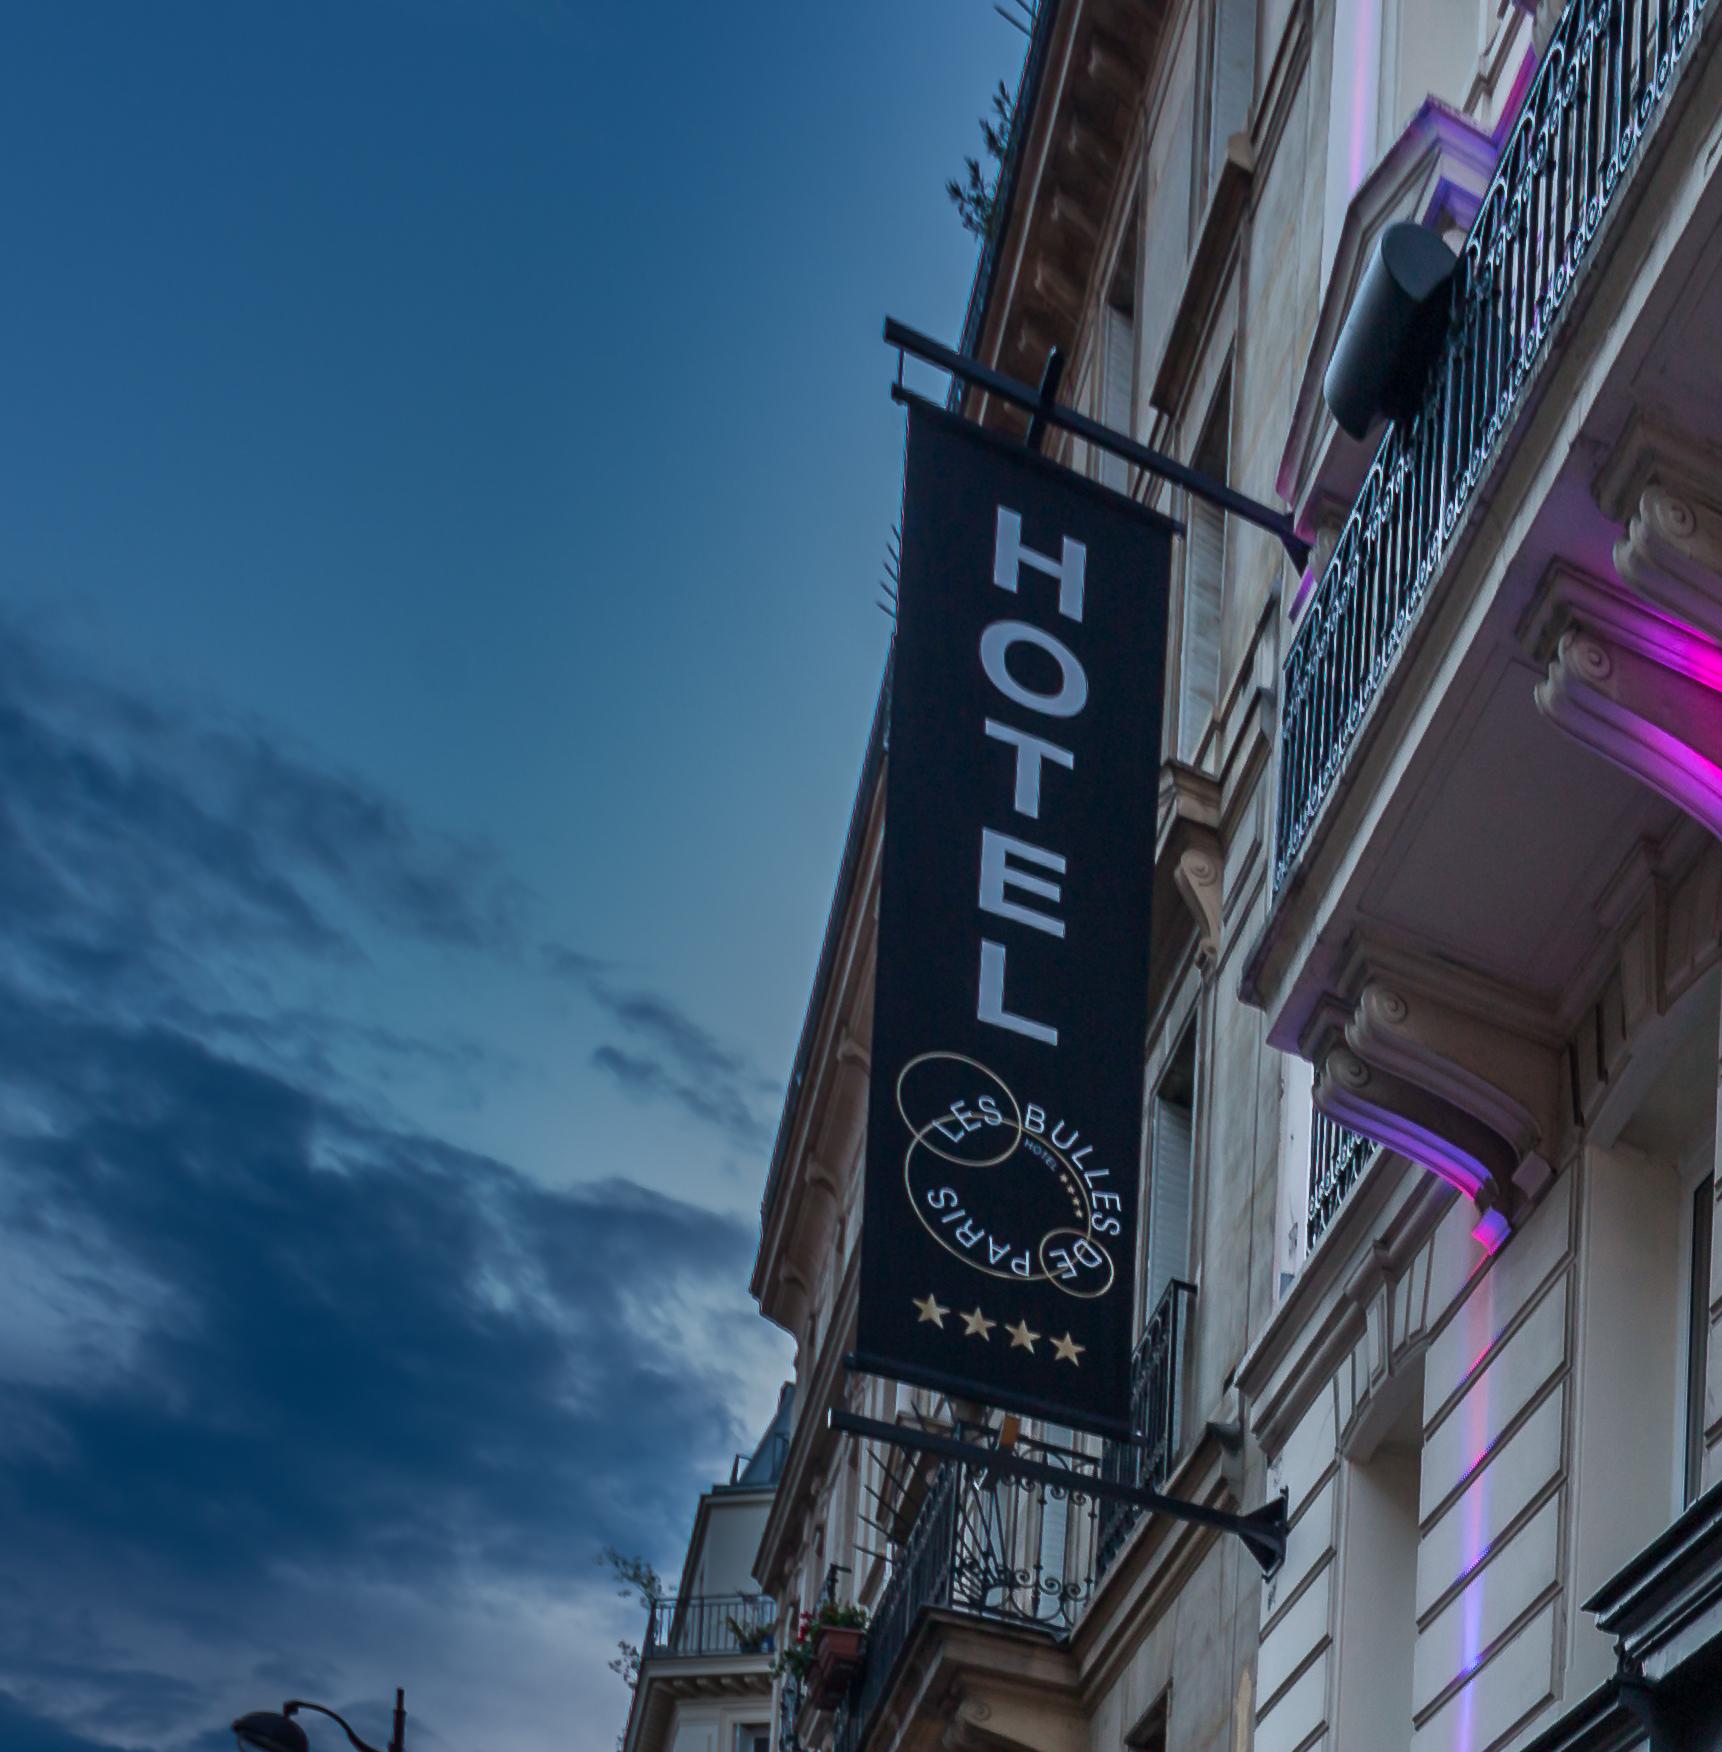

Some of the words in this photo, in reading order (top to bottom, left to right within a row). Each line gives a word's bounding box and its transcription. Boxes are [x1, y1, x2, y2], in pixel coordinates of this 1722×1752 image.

[977, 505, 1089, 1047] HOTEL
[932, 1095, 1003, 1143] LES
[1024, 1138, 1059, 1173] HOTEL
[1025, 1102, 1122, 1237] BULLES
[926, 1186, 1031, 1278] PARIS
[1050, 1238, 1103, 1280] DE
